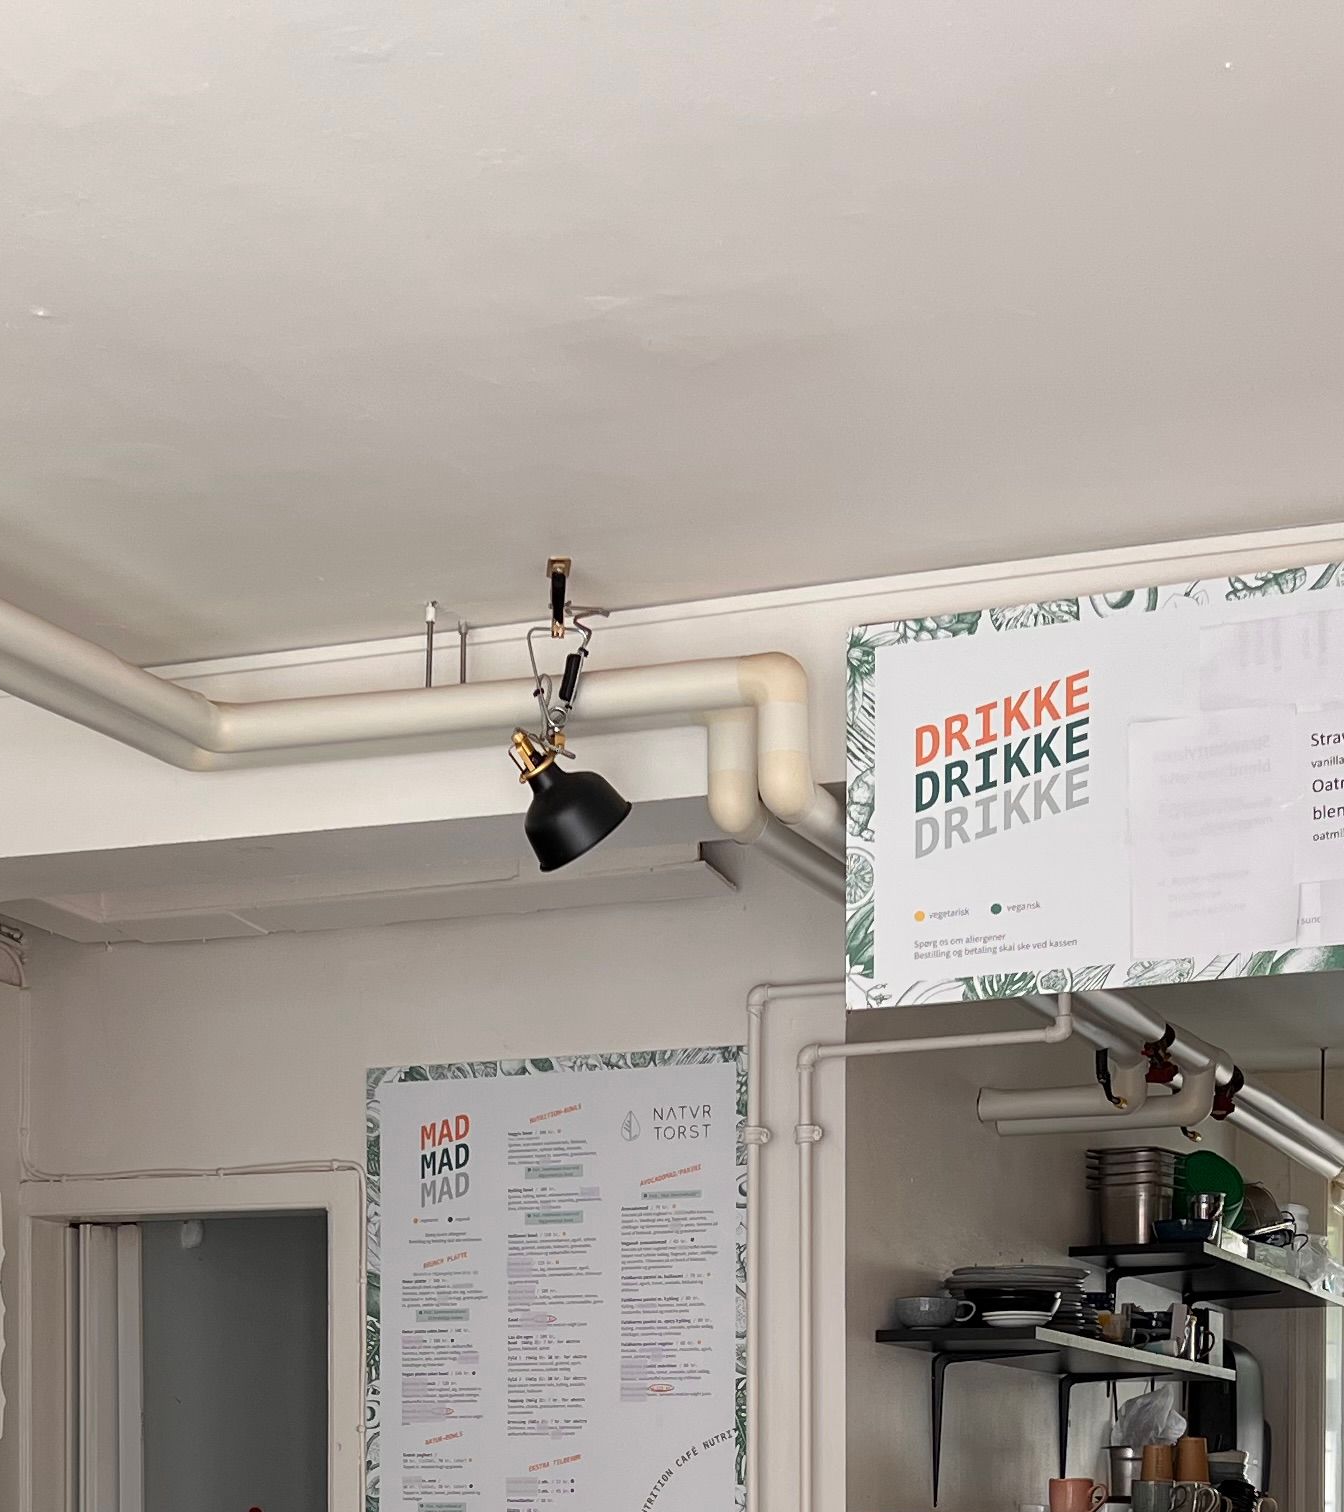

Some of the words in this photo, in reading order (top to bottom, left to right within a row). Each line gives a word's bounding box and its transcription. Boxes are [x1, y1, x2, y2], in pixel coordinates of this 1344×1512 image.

[915, 669, 1090, 767] DRIKKE
[915, 717, 1090, 813] DRIKKE
[1311, 755, 1344, 768] vanilla
[915, 764, 1090, 859] DRIKKE
[929, 908, 969, 920] vegetarisk
[1007, 901, 1040, 913] vegansk
[914, 940, 937, 950] Spørg
[914, 947, 950, 960] Bestilling
[952, 948, 962, 958] og
[964, 945, 997, 956] betaling
[1017, 942, 1030, 950] ske
[1033, 940, 1047, 949] ved
[1049, 939, 1077, 947] kassen
[654, 1105, 711, 1121] NATVR
[420, 1114, 470, 1151] MAD
[654, 1124, 711, 1140] TORST
[420, 1143, 470, 1179] MAD
[420, 1172, 470, 1208] MAD
[675, 1446, 699, 1467] CAFÉ
